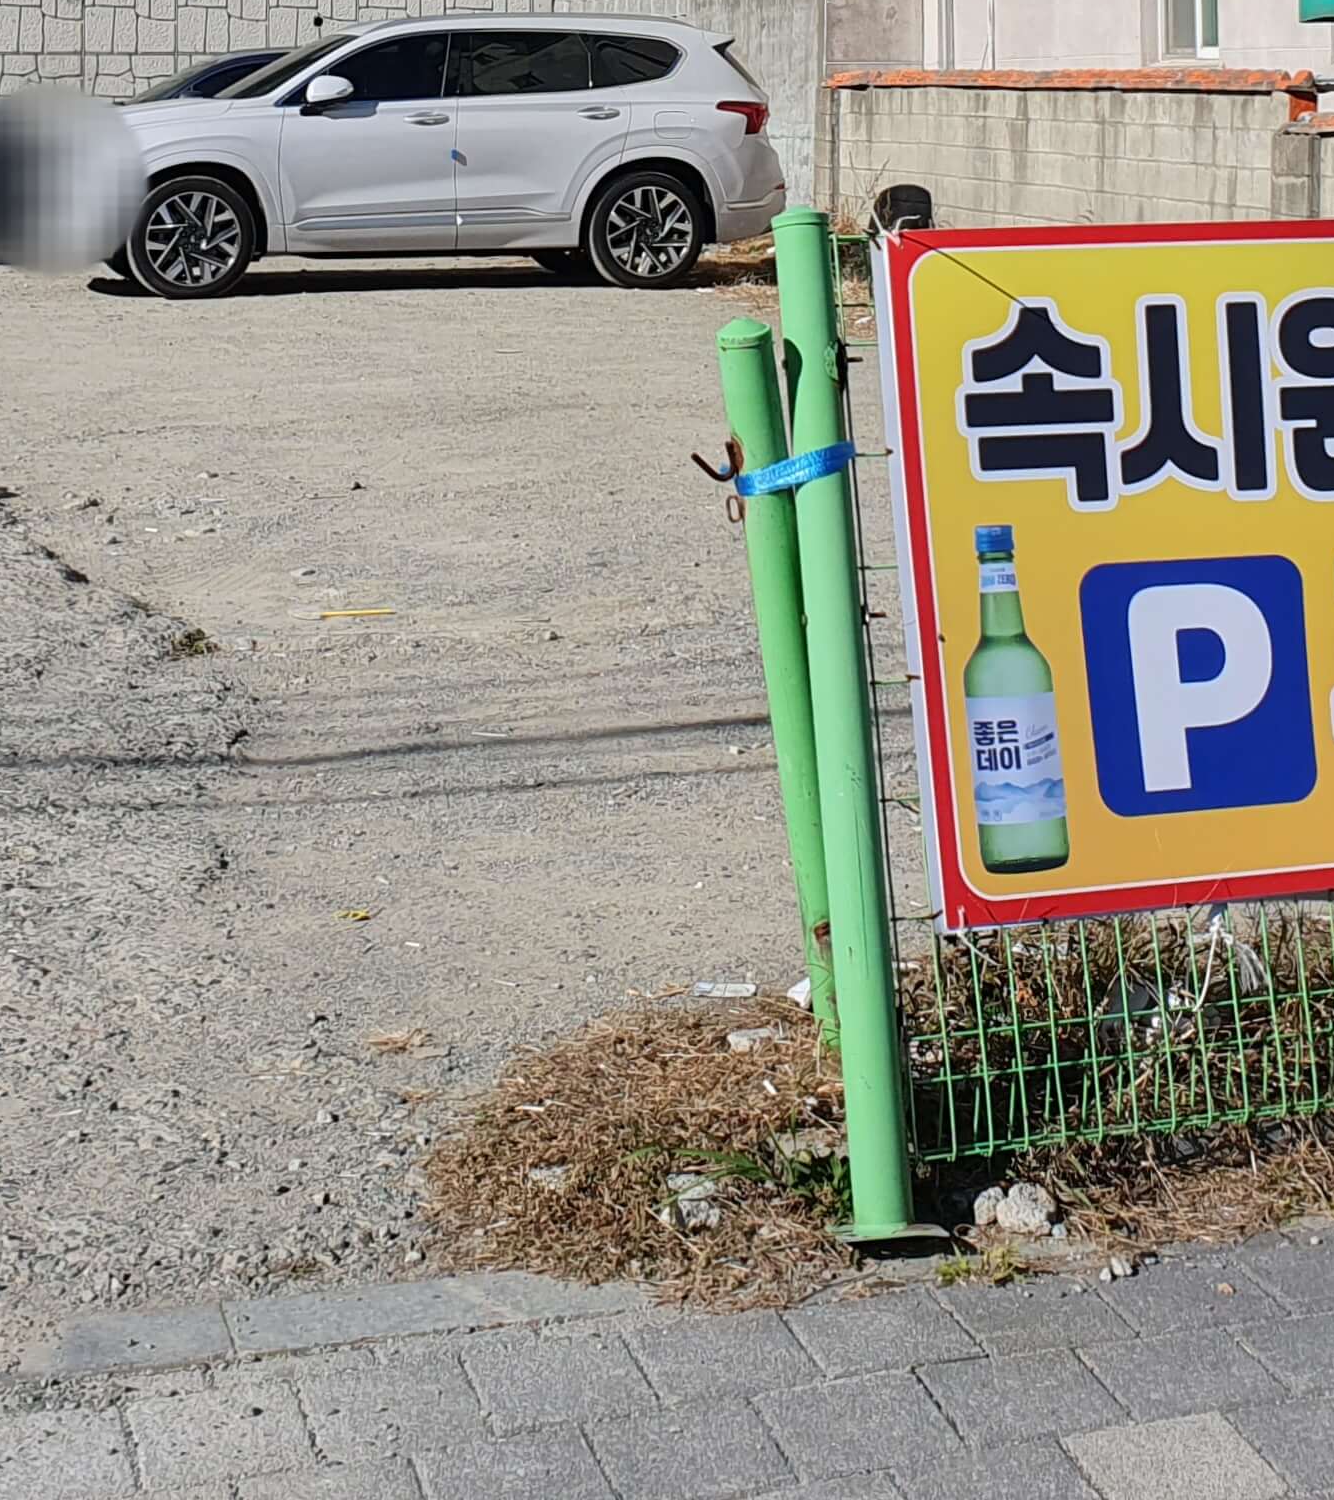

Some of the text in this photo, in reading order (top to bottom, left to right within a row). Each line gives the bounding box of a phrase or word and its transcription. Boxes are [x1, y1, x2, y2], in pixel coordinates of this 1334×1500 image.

[1126, 583, 1274, 791] P
[973, 720, 1019, 746] 좋은
[976, 746, 1022, 771] 데이
